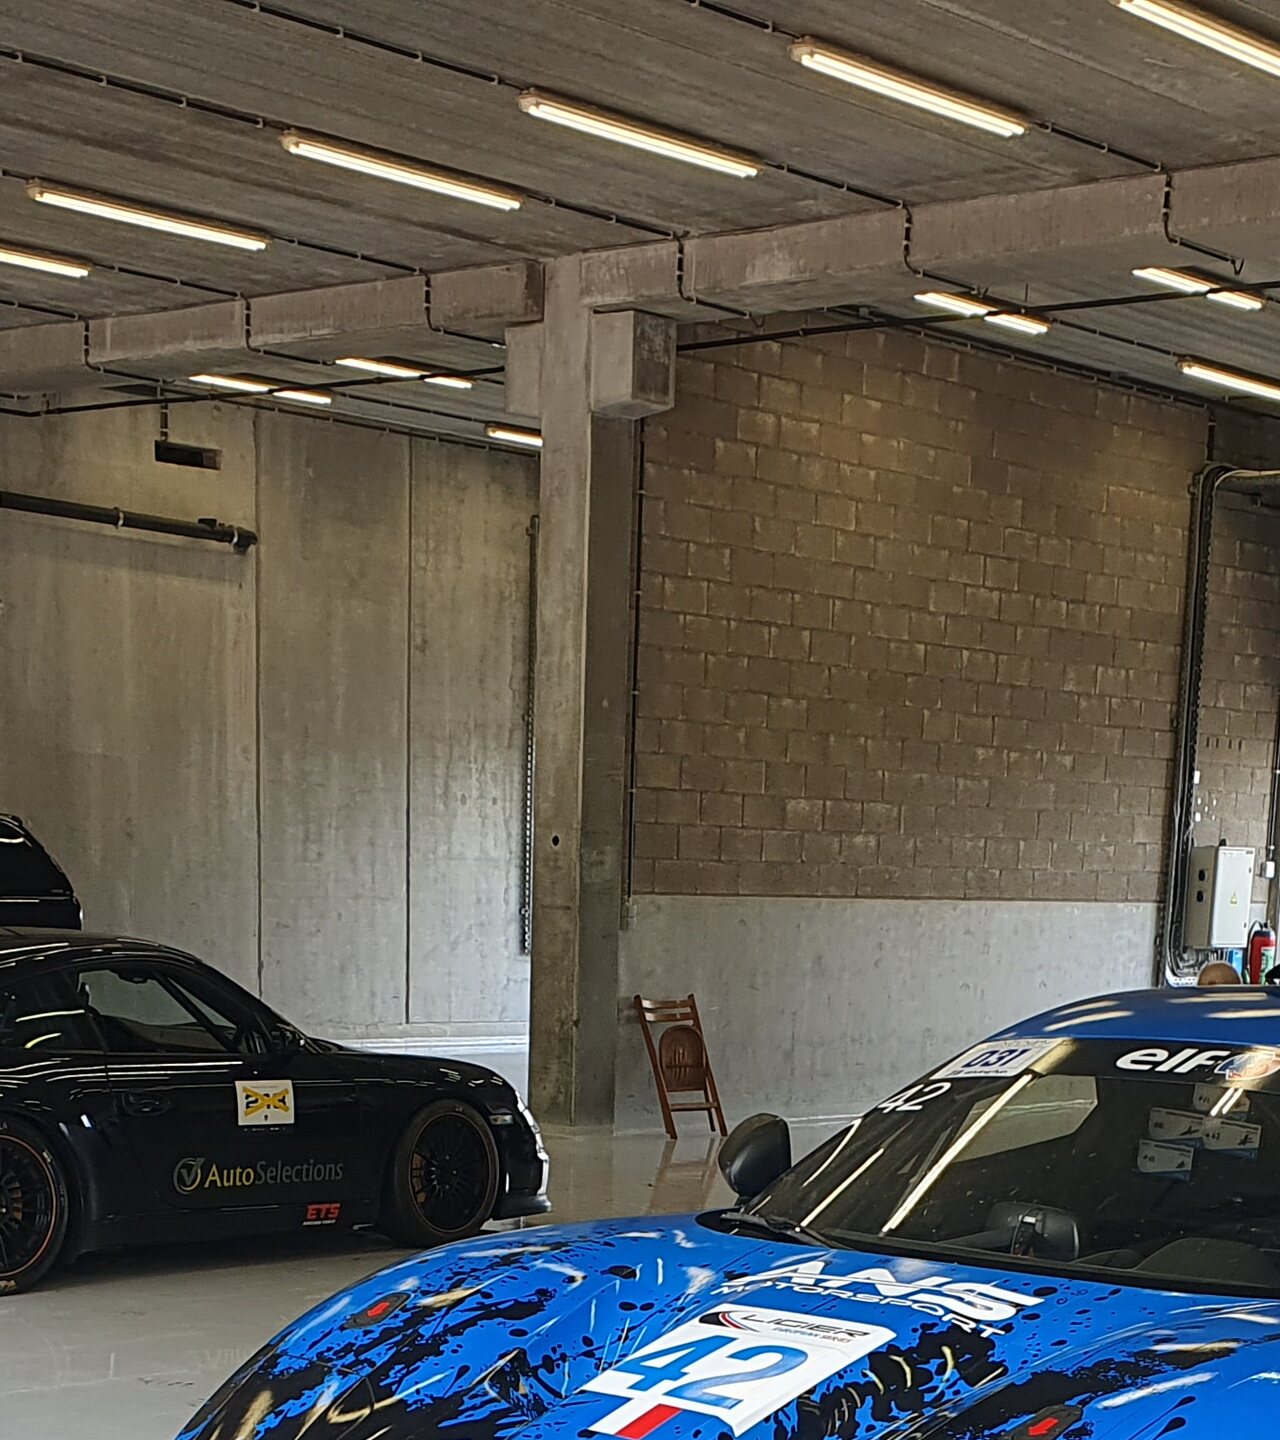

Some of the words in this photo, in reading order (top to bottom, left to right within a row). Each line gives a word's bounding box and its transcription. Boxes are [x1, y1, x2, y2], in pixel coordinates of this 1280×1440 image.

[1115, 1049, 1232, 1074] elf
[877, 1082, 952, 1114] 42
[306, 1203, 341, 1220] ETS
[720, 1260, 1045, 1321] ANS
[710, 1280, 1007, 1339] MOTORSPORT
[740, 1313, 871, 1338] LIGIER
[613, 1335, 808, 1410] 42
